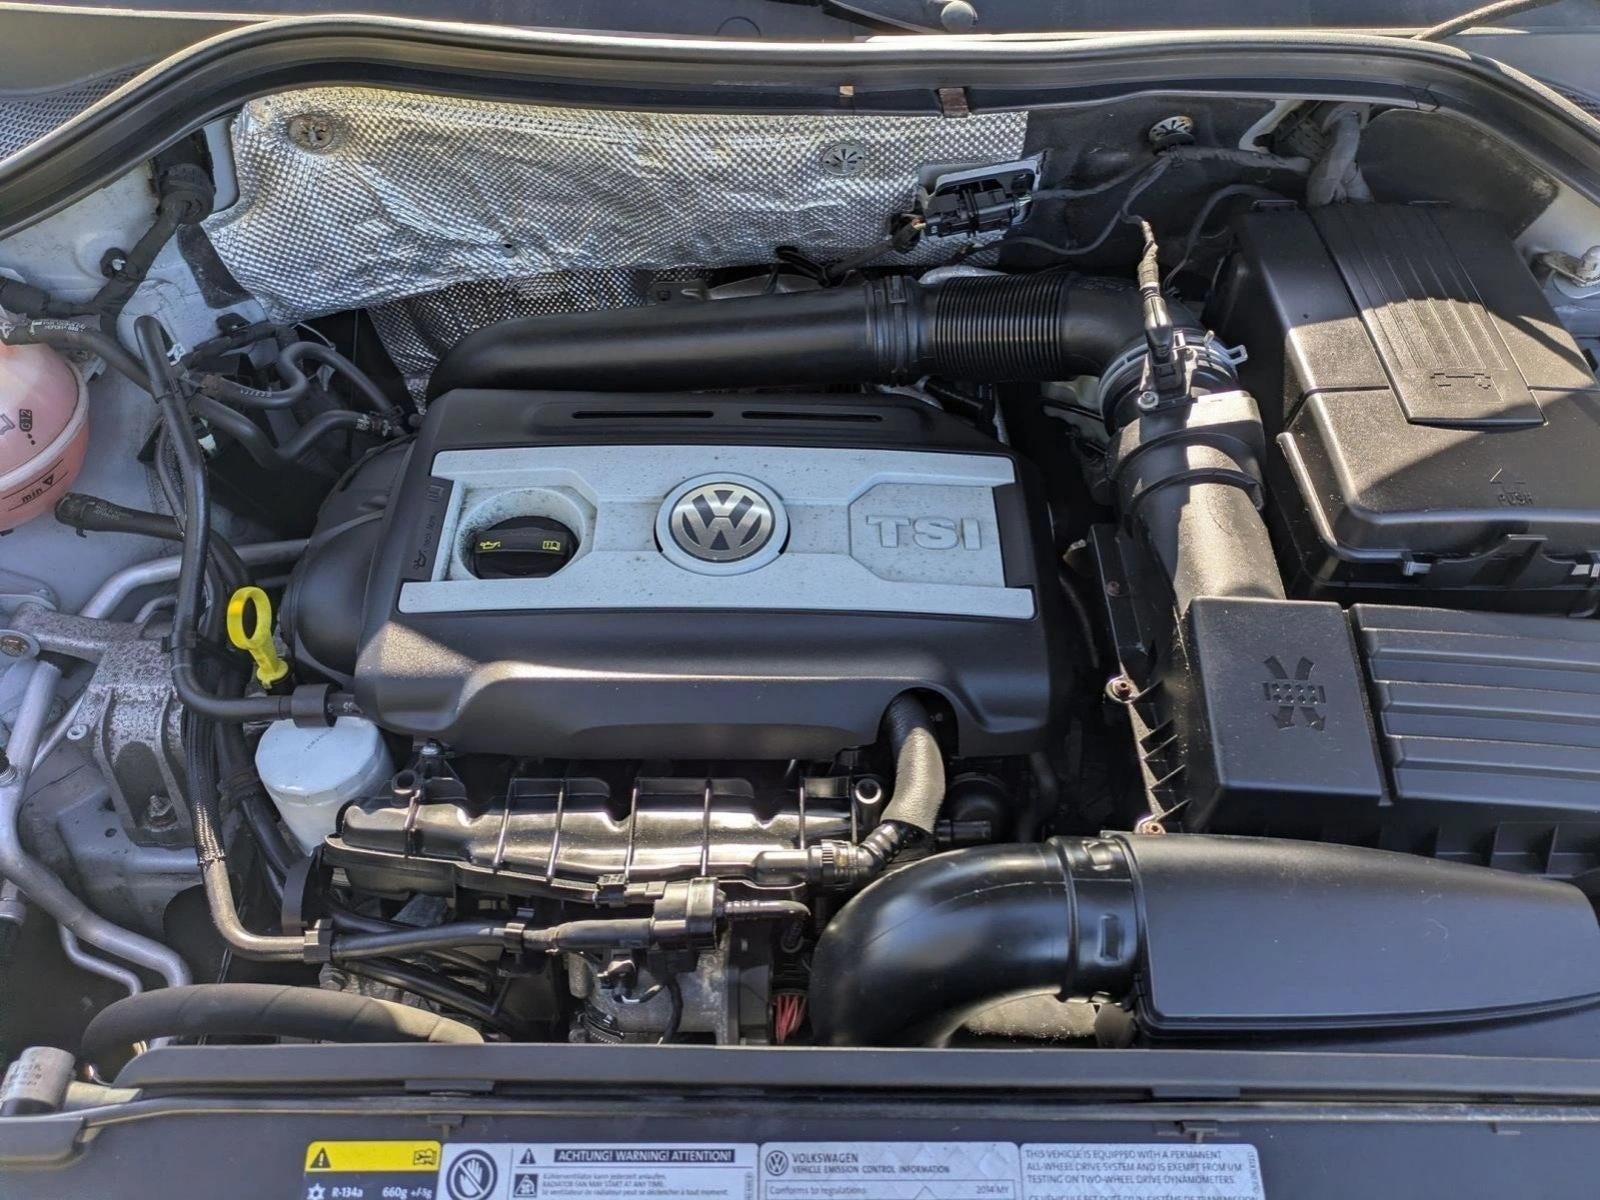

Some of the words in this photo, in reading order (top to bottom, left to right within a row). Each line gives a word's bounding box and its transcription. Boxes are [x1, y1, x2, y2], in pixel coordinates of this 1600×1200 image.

[20, 409, 32, 431] G12
[22, 487, 43, 504] min
[866, 515, 982, 551] TSI
[558, 1150, 612, 1161] ACHTUNG!
[615, 1150, 669, 1161] WARNING!
[671, 1150, 731, 1161] ATTENTION!
[792, 1153, 858, 1163] VOLKSWAGEN
[1026, 1150, 1045, 1158] THIS
[1045, 1150, 1081, 1158] VEHICLE
[1083, 1150, 1091, 1158] IS
[1093, 1150, 1135, 1160] EQUIPPED
[1138, 1150, 1160, 1158] WITH
[1162, 1150, 1168, 1158] A
[1170, 1150, 1221, 1158] PERMANENT
[1027, 1163, 1073, 1171] ALL-WHEEL
[1075, 1163, 1101, 1171] DRIVE
[1103, 1163, 1133, 1171] SYSTEM
[1137, 1163, 1155, 1171] AND
[1157, 1163, 1165, 1171] IS
[1167, 1163, 1200, 1171] EXEMPT
[1202, 1163, 1226, 1171] FROM
[1027, 1175, 1062, 1183] TESTING
[1065, 1175, 1078, 1183] ON
[1080, 1175, 1134, 1183] TWO-WHEEL
[1137, 1175, 1160, 1183] DRIVE
[332, 1187, 363, 1198] R-134a
[382, 1187, 407, 1200] 660g
[769, 1186, 808, 1194] Conforms
[811, 1186, 819, 1194] to
[977, 1186, 994, 1194] 2014
